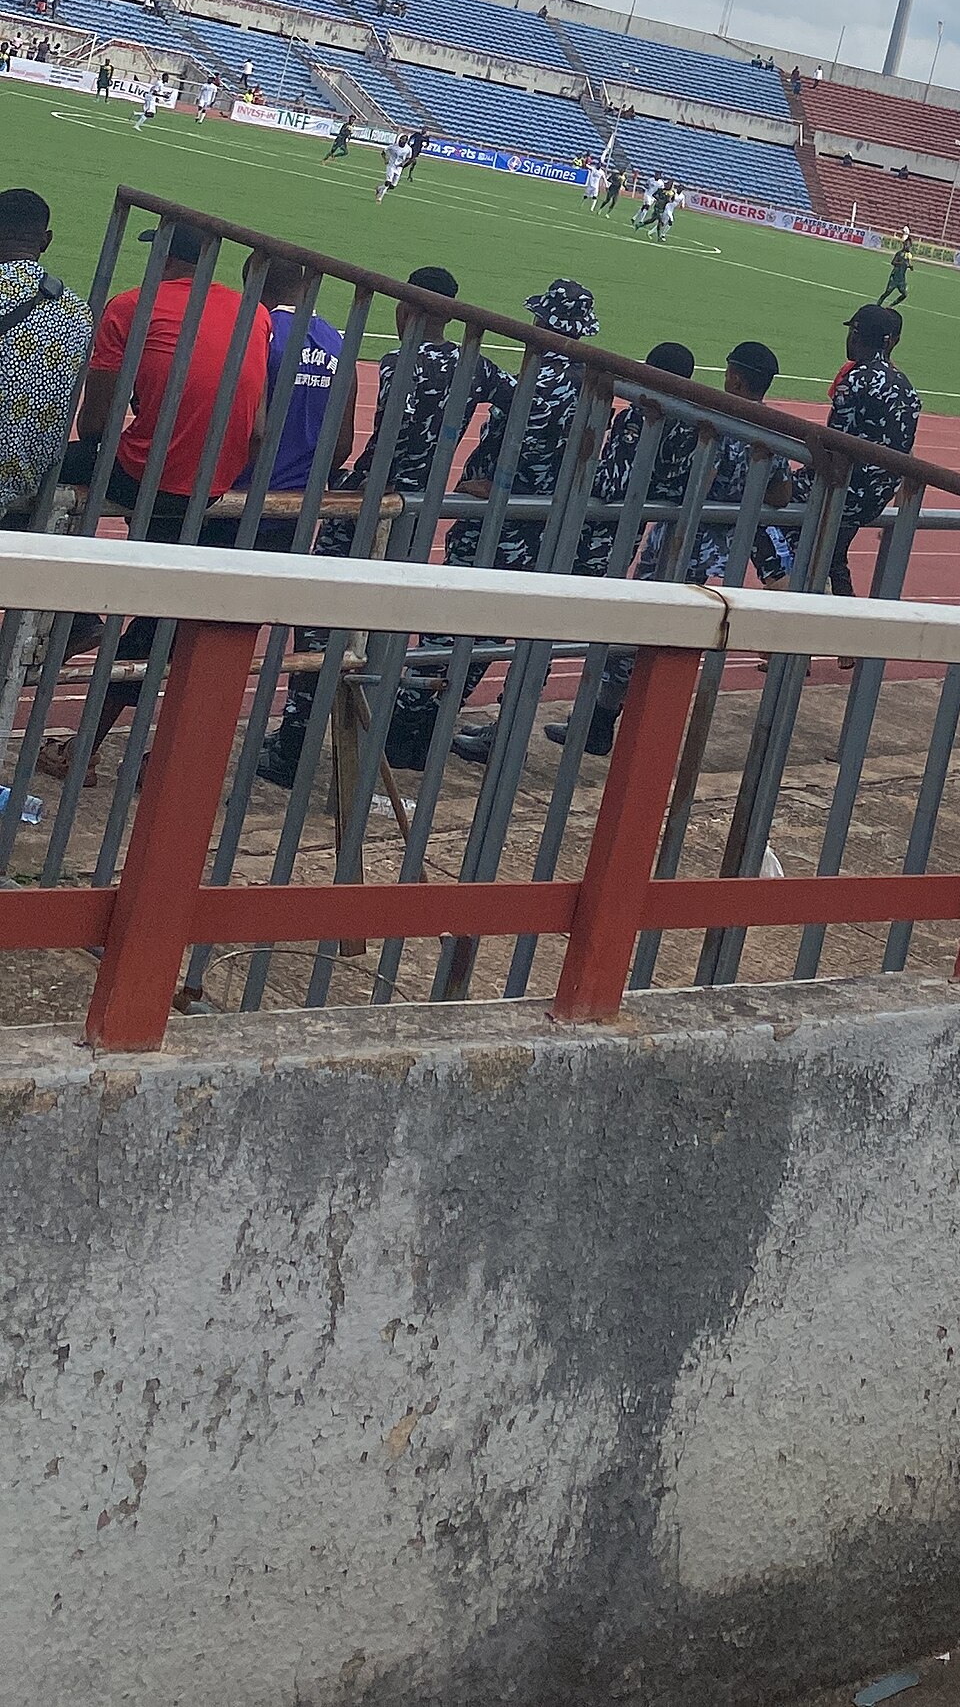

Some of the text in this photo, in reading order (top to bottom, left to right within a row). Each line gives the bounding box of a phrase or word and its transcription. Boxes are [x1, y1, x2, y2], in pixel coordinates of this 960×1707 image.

[276, 109, 311, 131] TNFF
[522, 160, 577, 181] StarTimes
[700, 196, 767, 221] RANGERS
[795, 216, 827, 229] PLAYERS
[828, 222, 843, 232] SAY
[856, 229, 866, 237] TO
